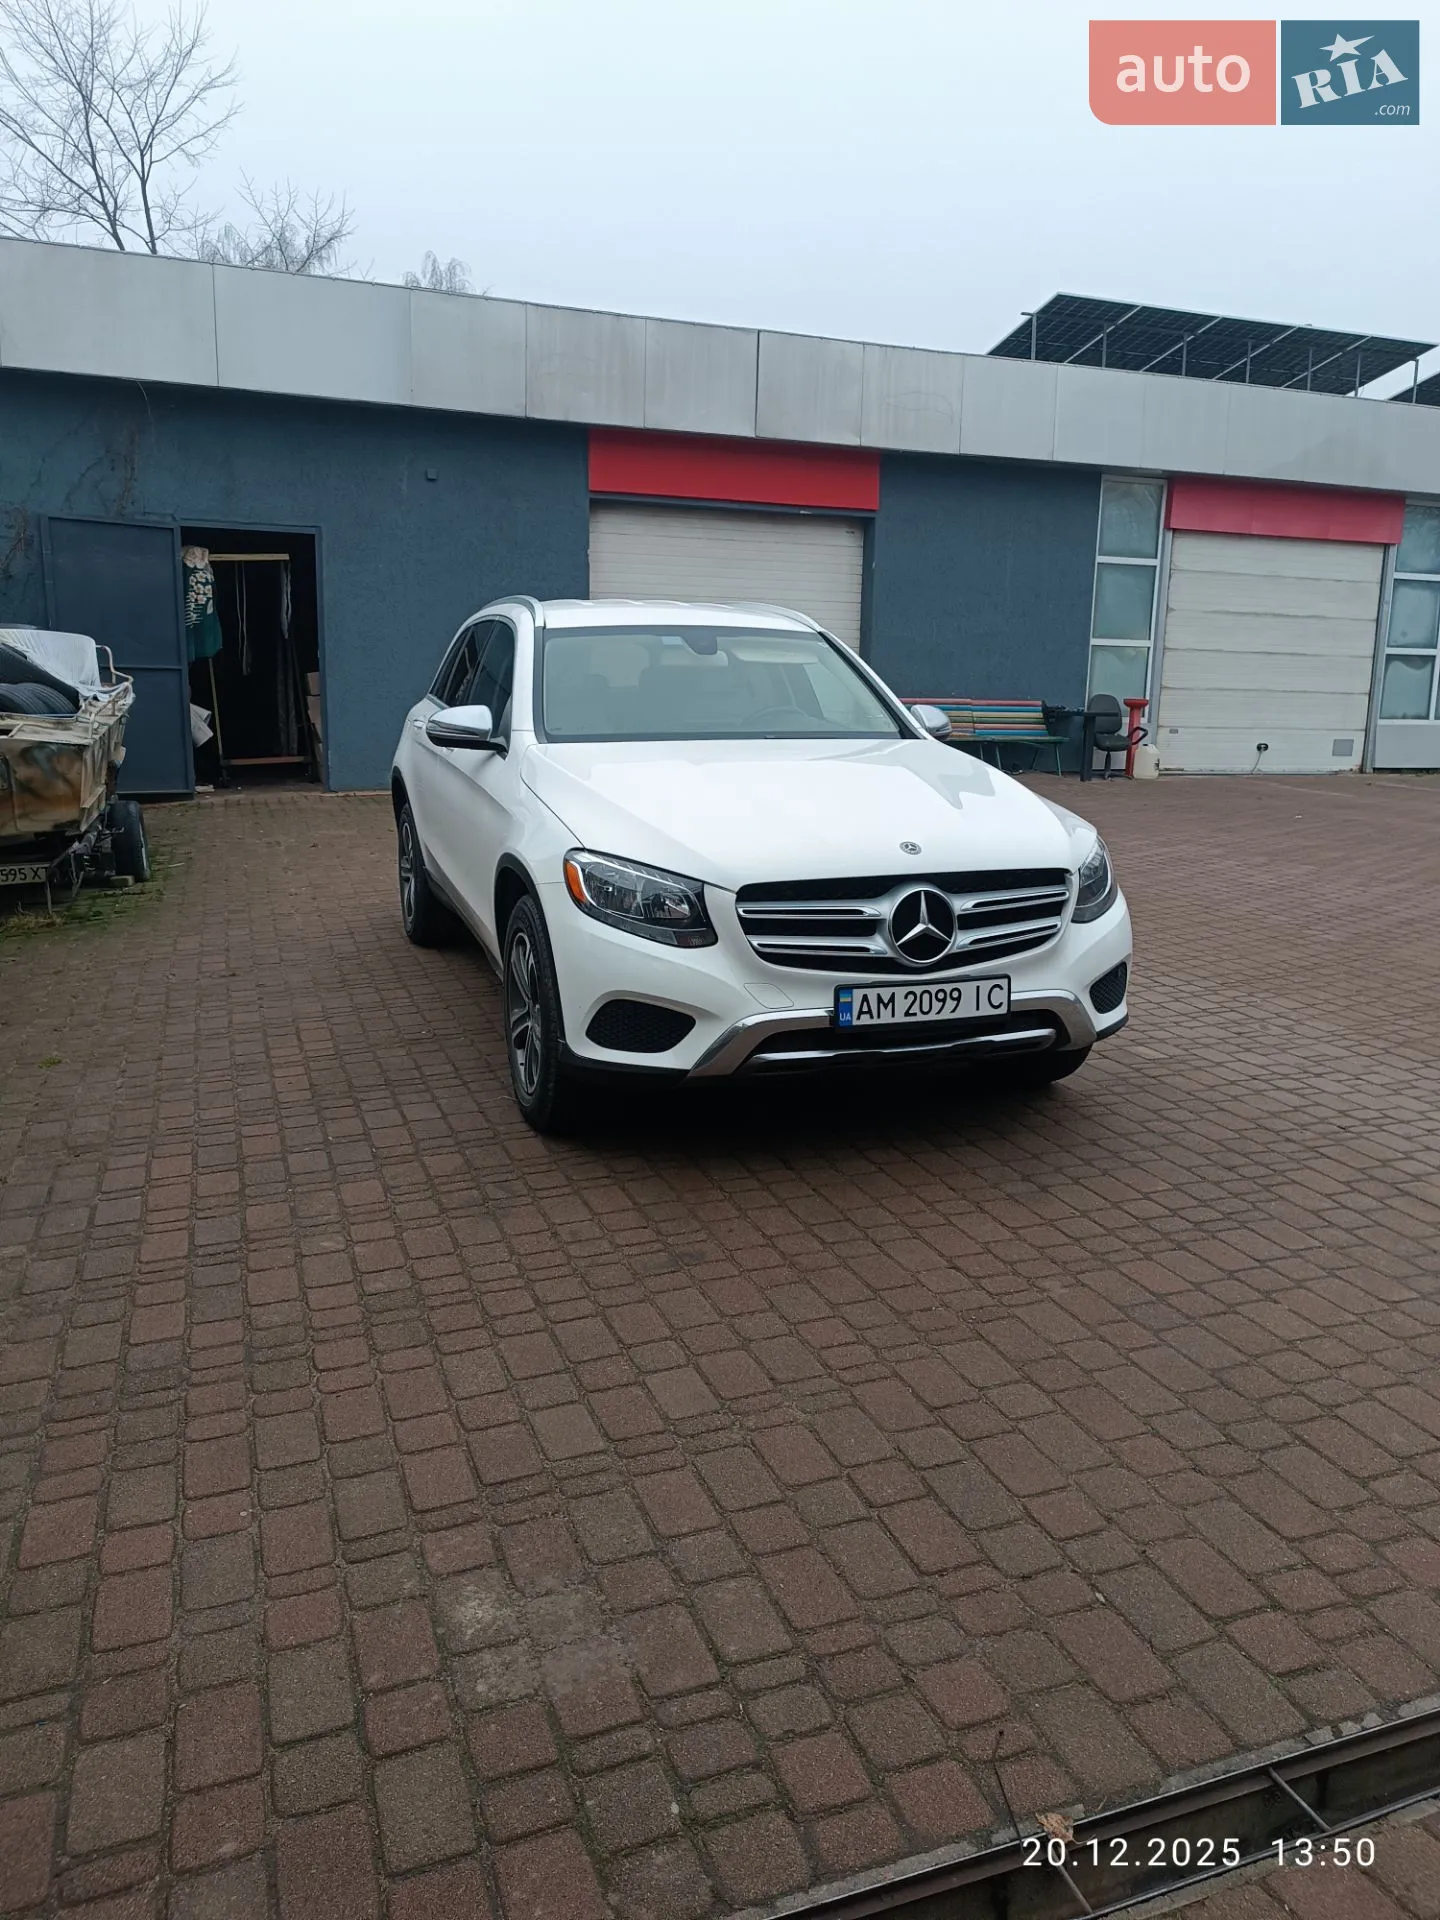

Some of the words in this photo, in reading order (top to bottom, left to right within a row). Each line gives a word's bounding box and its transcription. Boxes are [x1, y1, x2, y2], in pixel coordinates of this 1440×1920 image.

[855, 991, 896, 1021] AM
[903, 987, 962, 1018] 2099
[975, 983, 1004, 1011] IC
[839, 1012, 852, 1022] UA
